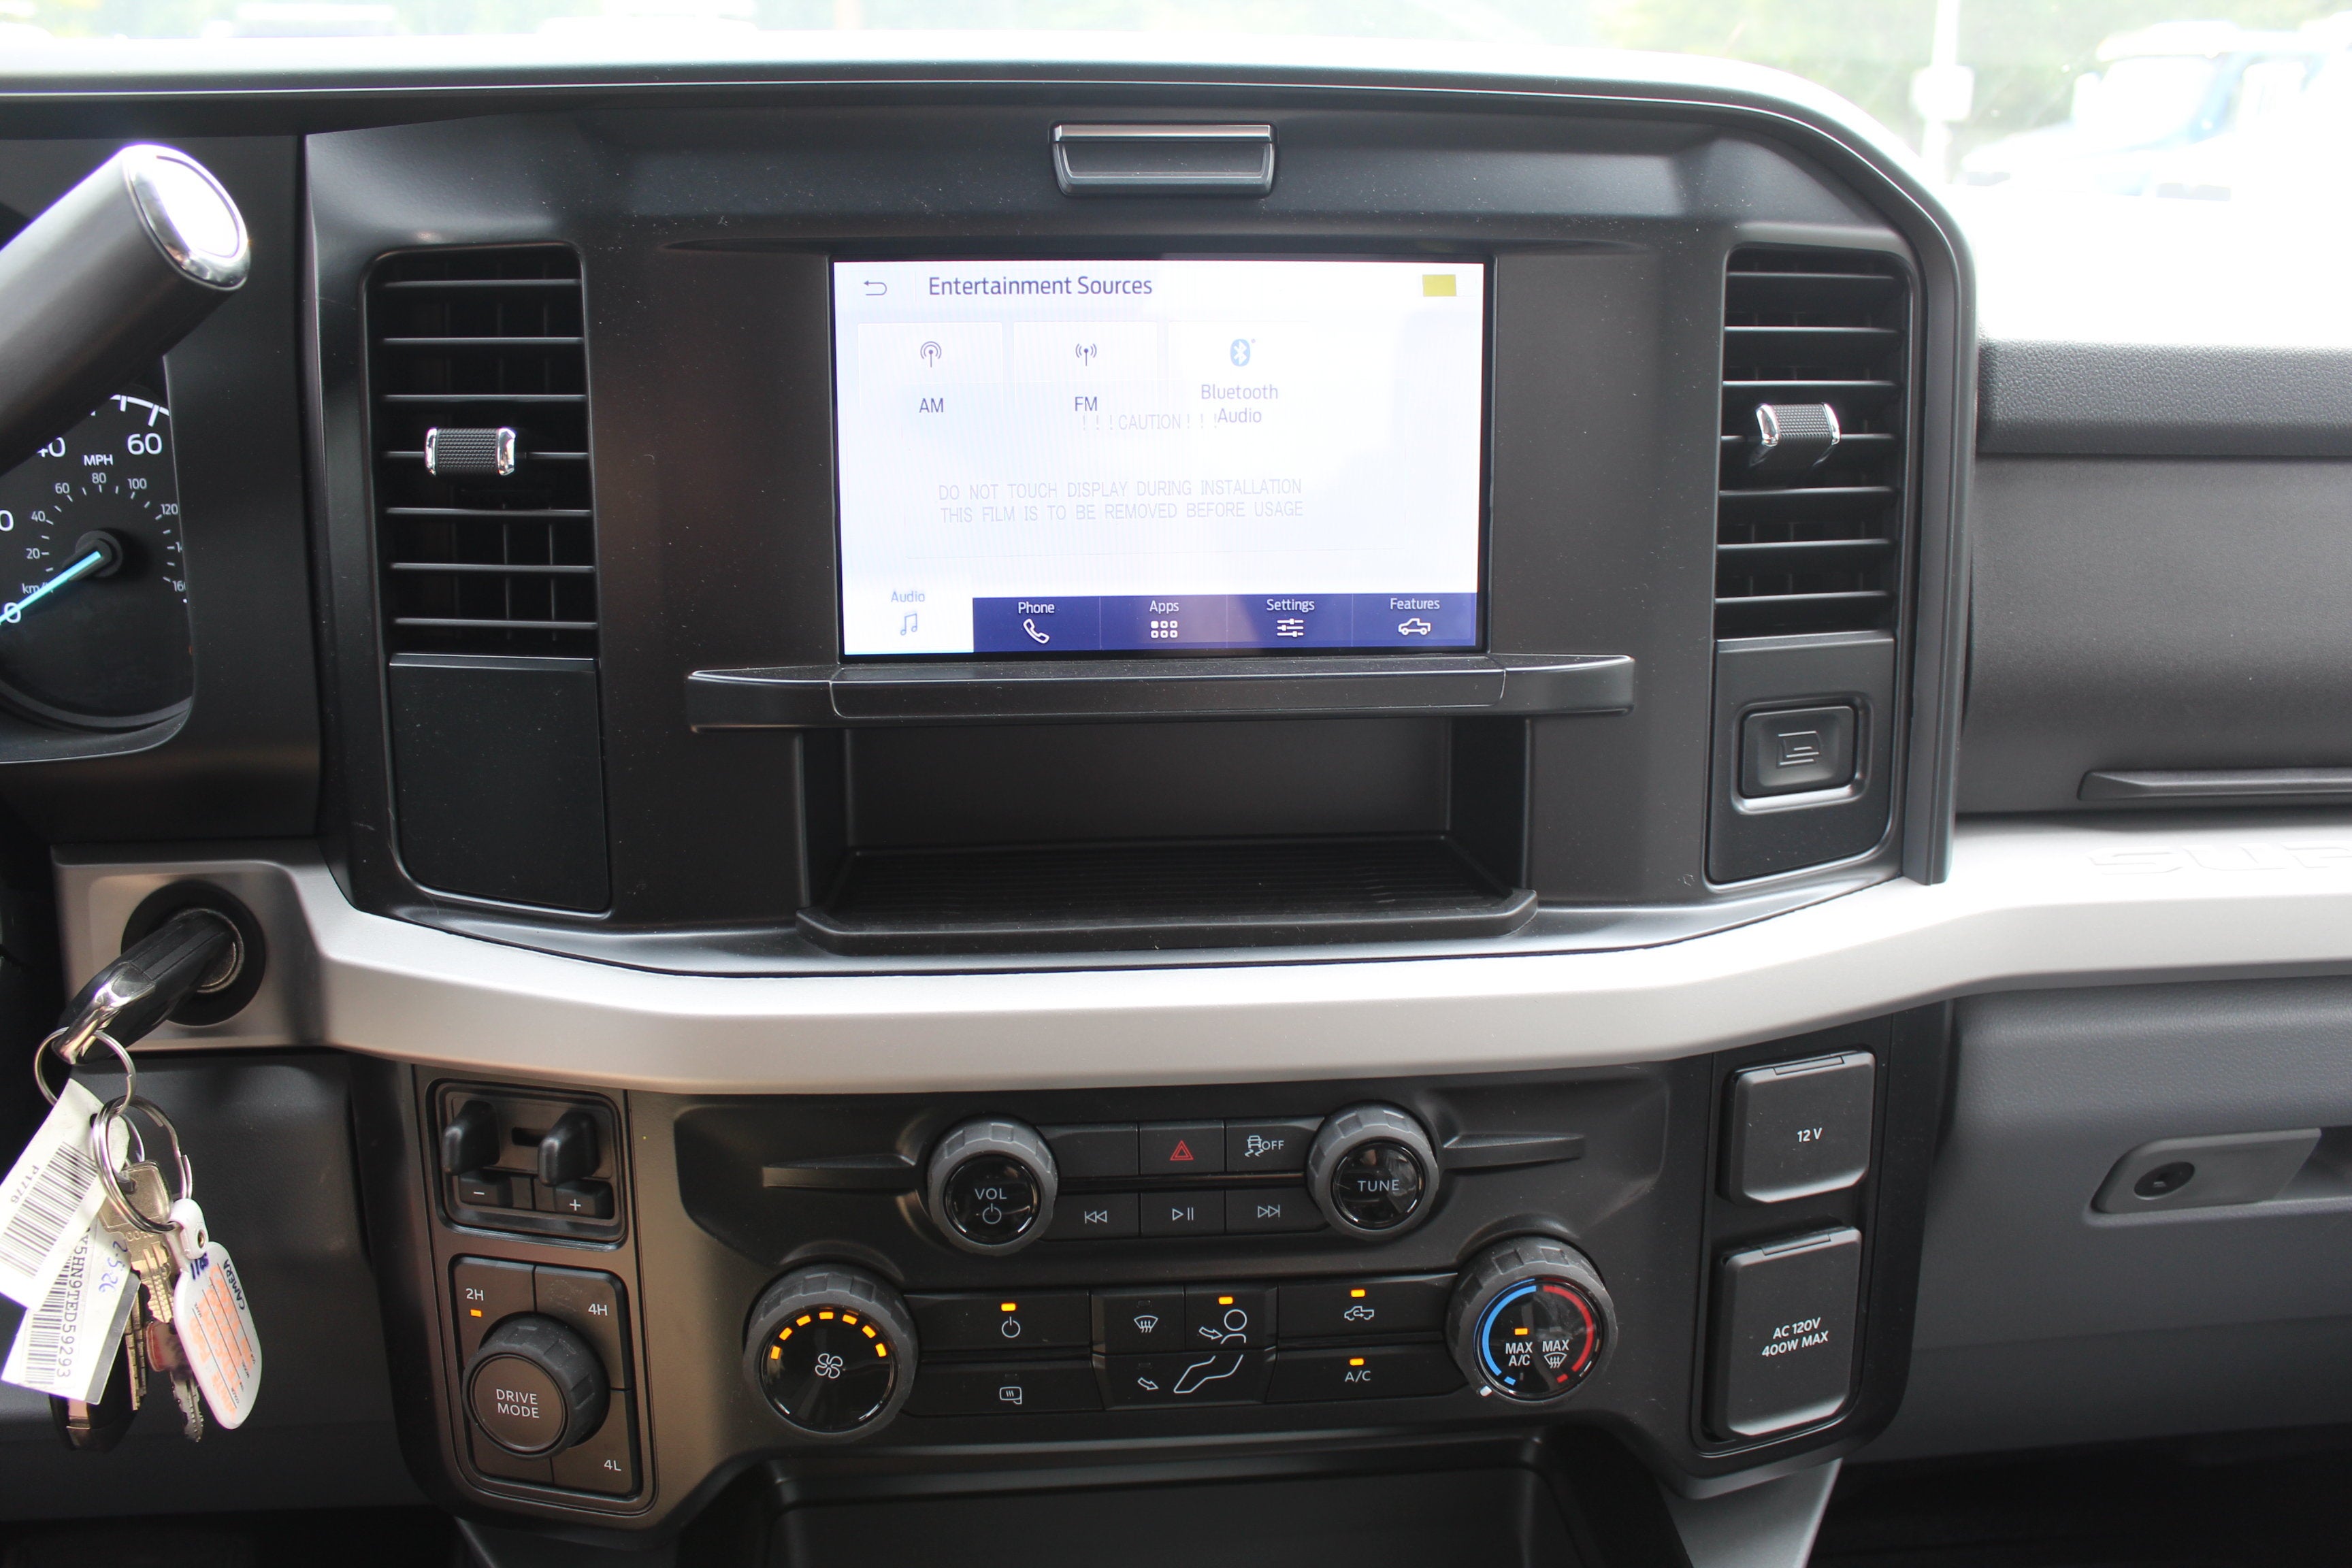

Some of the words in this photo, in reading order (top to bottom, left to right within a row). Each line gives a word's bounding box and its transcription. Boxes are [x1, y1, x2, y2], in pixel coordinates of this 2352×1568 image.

[928, 276, 1072, 295] Entertainment
[1077, 276, 1152, 295] Sources
[1201, 384, 1279, 399] Bluetooth
[919, 397, 944, 413] AM
[1074, 396, 1098, 412] FM
[1218, 408, 1262, 423] Audio
[127, 433, 163, 455] 60
[84, 454, 114, 466] MPH
[91, 472, 107, 484] 80
[127, 478, 147, 490] 100
[55, 483, 70, 494] 60
[938, 484, 960, 500] DO
[969, 483, 999, 500] NOT
[1007, 483, 1058, 499] TOUCH
[1067, 481, 1128, 497] DISPLAY
[1137, 480, 1192, 496] DURING
[1200, 478, 1301, 495] INSTALLATION
[161, 503, 178, 515] 120
[941, 507, 973, 523] THIS
[982, 506, 1015, 523] FILM
[1024, 505, 1038, 521] IS
[1047, 505, 1066, 521] TO
[1076, 504, 1096, 520] BE
[1105, 503, 1177, 519] REMOVED
[1186, 502, 1245, 518] BEFORE
[1254, 501, 1303, 517] USAGE
[31, 510, 46, 522] 40
[26, 548, 40, 559] 20
[172, 580, 186, 592] 16
[891, 591, 926, 603] Audio
[1390, 597, 1440, 610] Features
[1017, 601, 1056, 614] Phone
[1149, 600, 1179, 613] Apps
[1266, 598, 1315, 612] Settings
[1797, 1129, 1811, 1143] 12
[1262, 1140, 1284, 1151] OFF
[1357, 1179, 1400, 1192] TUNE
[975, 1188, 1007, 1200] VOL
[223, 1258, 246, 1311] CAMERA
[465, 1288, 485, 1301] 2H
[587, 1303, 608, 1316] 4H
[1772, 1324, 1791, 1339] AC
[1791, 1316, 1821, 1335] 120V
[1505, 1341, 1533, 1354] MAX
[1542, 1339, 1570, 1352] MAX
[1761, 1338, 1799, 1357] 400W
[1801, 1330, 1829, 1348] MAX
[1508, 1354, 1531, 1367] A/C
[1344, 1370, 1371, 1382] A/C
[495, 1388, 538, 1405] DRIVE
[497, 1402, 540, 1419] MODE
[603, 1458, 622, 1472] 4L
